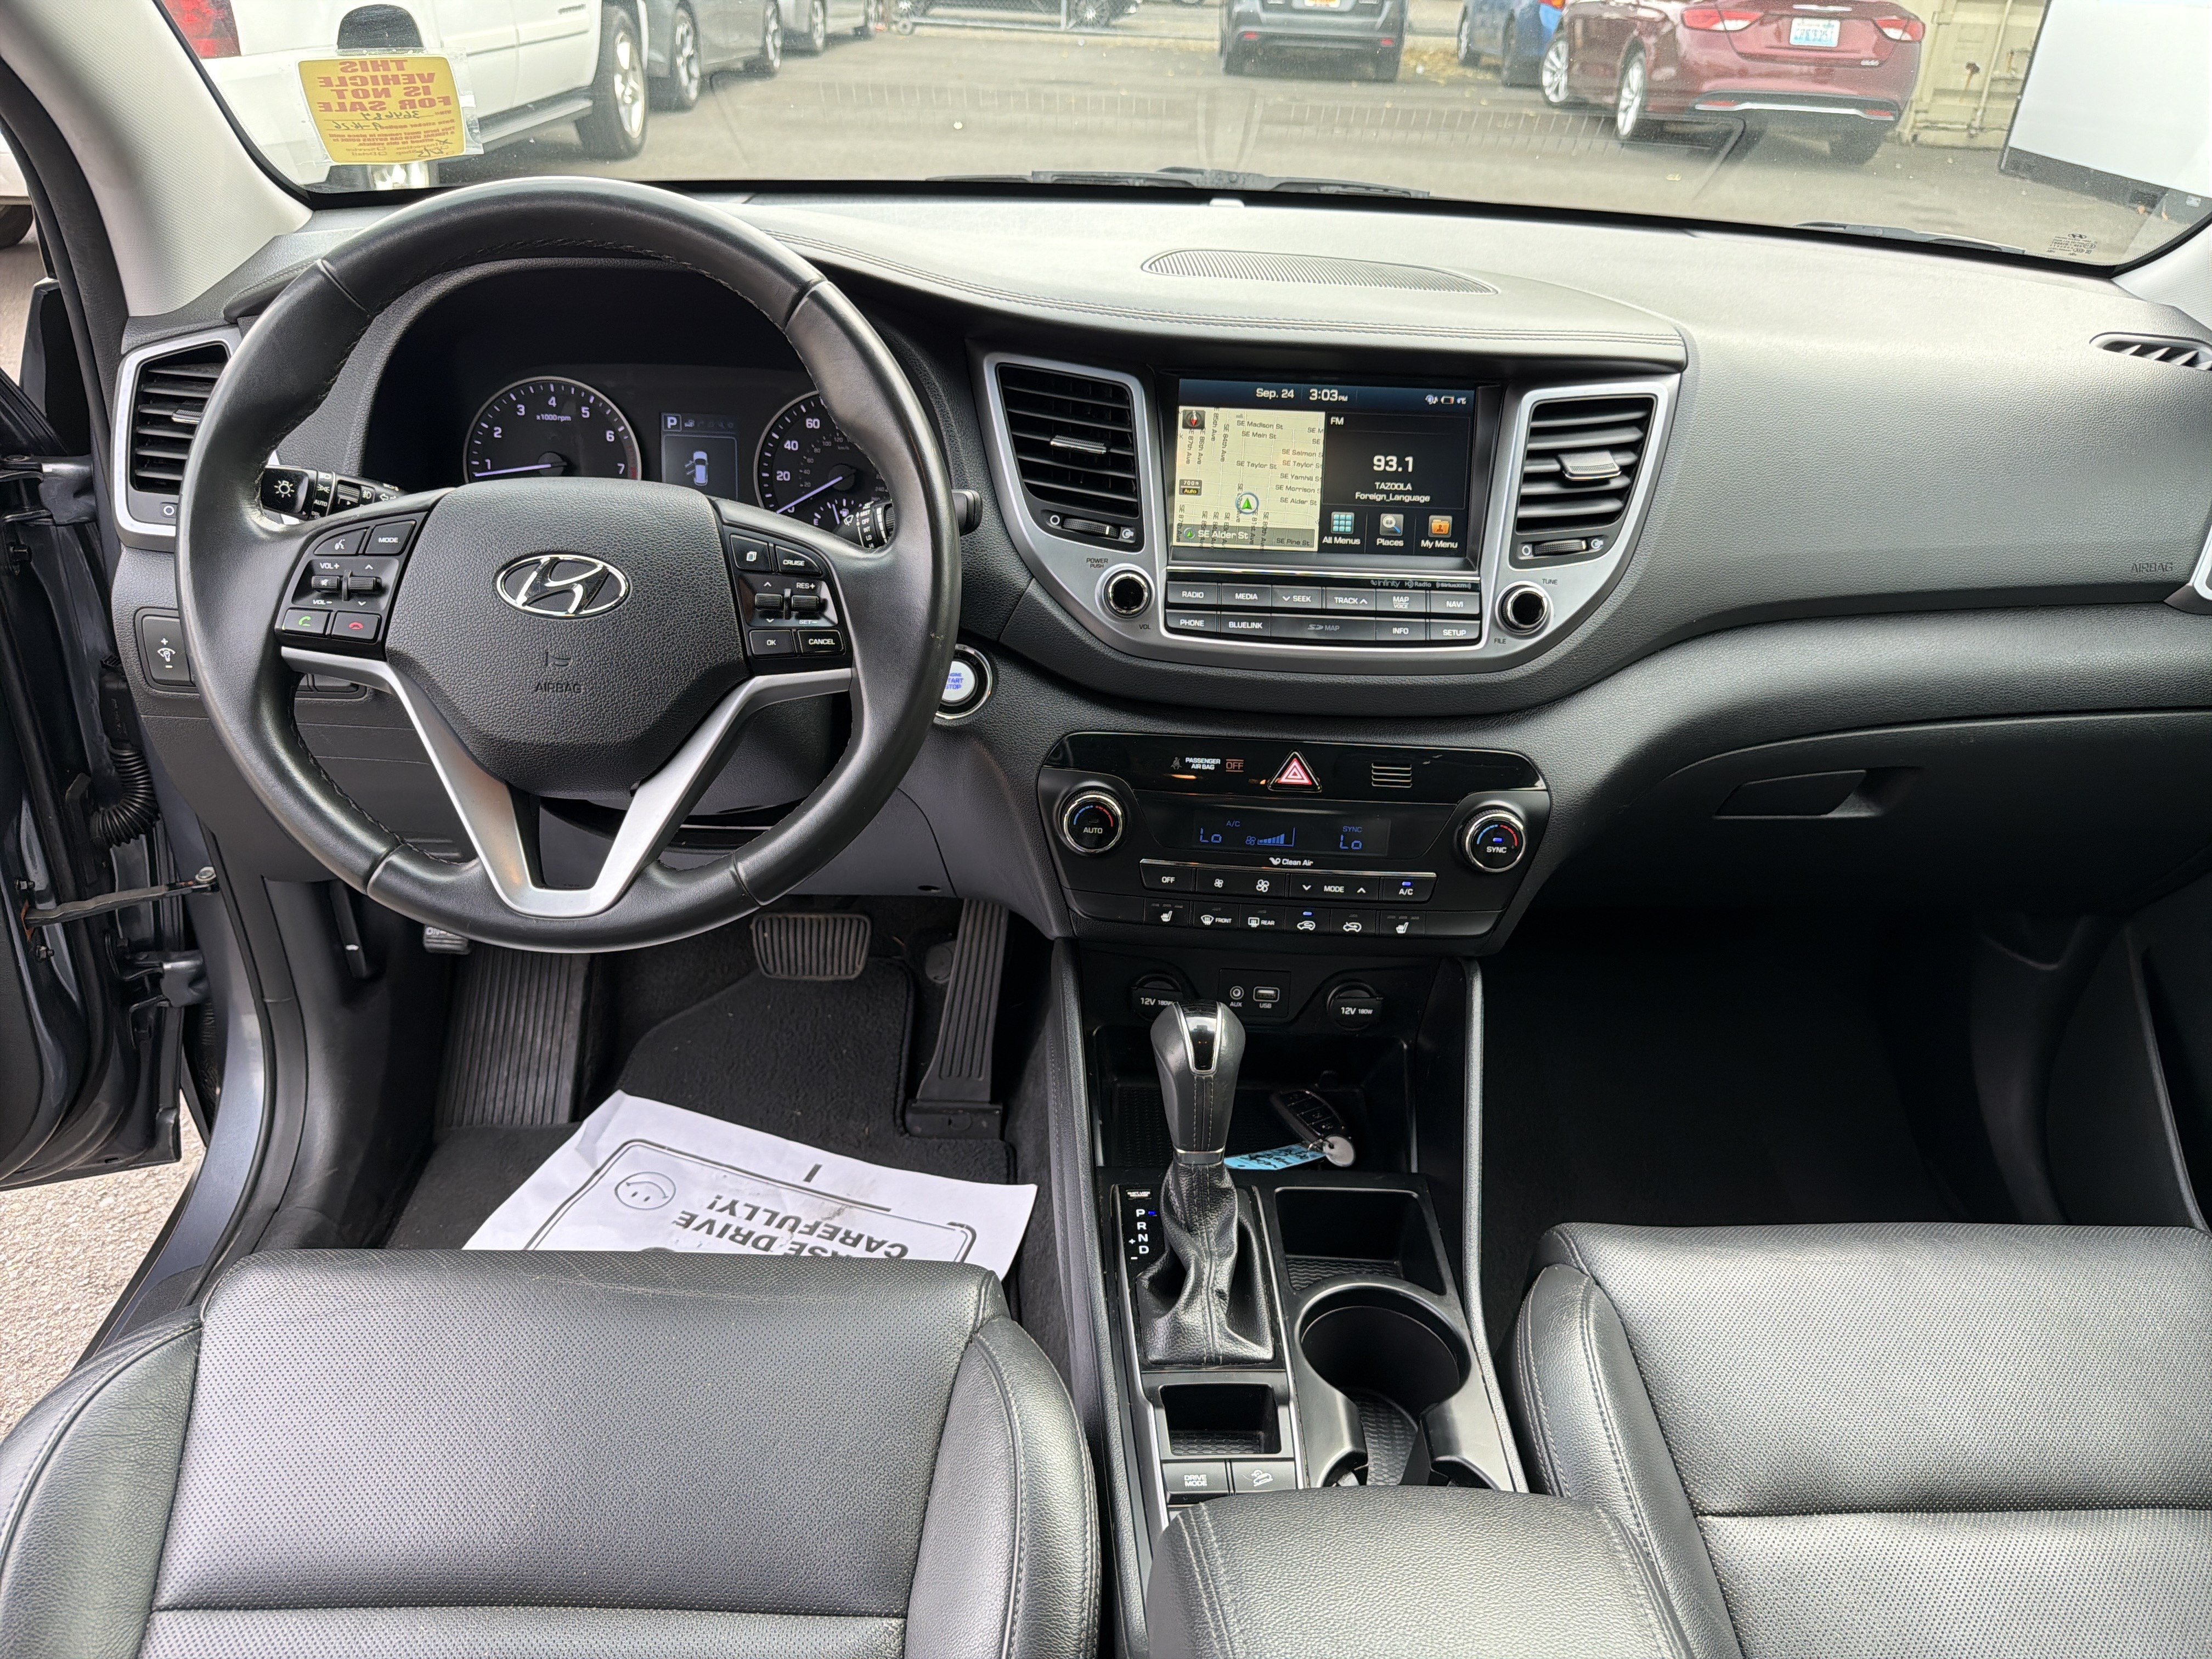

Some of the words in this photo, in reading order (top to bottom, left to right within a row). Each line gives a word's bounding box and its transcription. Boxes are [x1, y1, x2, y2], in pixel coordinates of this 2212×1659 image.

[1256, 387, 1279, 400] Sep.
[1281, 389, 1295, 399] 24
[548, 396, 557, 407] 4
[516, 404, 526, 416] 3
[581, 406, 590, 419] 5
[667, 416, 678, 429] P
[805, 417, 821, 429] 60
[1246, 421, 1274, 429] Madison
[1330, 416, 1344, 426] FM
[493, 426, 503, 439] 2
[1223, 424, 1229, 432] SE
[606, 430, 615, 442] 6
[783, 439, 799, 451] 40
[484, 459, 492, 470] 1
[1246, 461, 1268, 470] Taylor
[1373, 455, 1414, 472] 93.1
[617, 462, 625, 475] 7
[776, 470, 791, 482] 20
[1290, 473, 1313, 482] Yamhill
[1237, 483, 1244, 492] SE
[1285, 485, 1316, 494] Morrison
[1375, 481, 1412, 491] TAZOOLA
[1355, 492, 1431, 503] Foreign_Language
[314, 499, 328, 507] AUTO
[1179, 504, 1185, 514] SE
[1201, 510, 1208, 520] SE
[1213, 511, 1219, 520] SE
[1224, 512, 1231, 521] SE
[1263, 511, 1269, 521] SE
[813, 517, 820, 526] E
[1198, 529, 1210, 538] SE
[1211, 531, 1237, 539] Alder
[1238, 531, 1249, 540] St
[1322, 536, 1333, 544] All
[1334, 537, 1361, 545] Menus
[1376, 538, 1404, 547] Places
[1421, 540, 1434, 548] My
[1435, 540, 1458, 549] Menu
[2131, 563, 2173, 573] AIRBAG
[1182, 591, 1204, 599] RADIO
[1235, 592, 1258, 601] MEDIA
[1334, 596, 1358, 605] TRACK
[1446, 600, 1464, 608] NAVI
[1180, 619, 1204, 627] PHONE
[1228, 621, 1263, 629] BLUELINK
[1392, 627, 1409, 635] INFO
[1442, 629, 1466, 637] SETUP
[534, 682, 582, 693] AIRBAG
[1225, 761, 1244, 770] OFF
[1398, 888, 1414, 896] A/C
[1140, 997, 1156, 1006] 12V
[1341, 1007, 1357, 1015] 12V
[1136, 1209, 1146, 1217] P
[706, 1194, 909, 1260] CAREFULLY!
[1137, 1222, 1147, 1230] R
[672, 1210, 780, 1253] DRIVE
[1138, 1233, 1148, 1243] N
[1138, 1245, 1149, 1254] D
